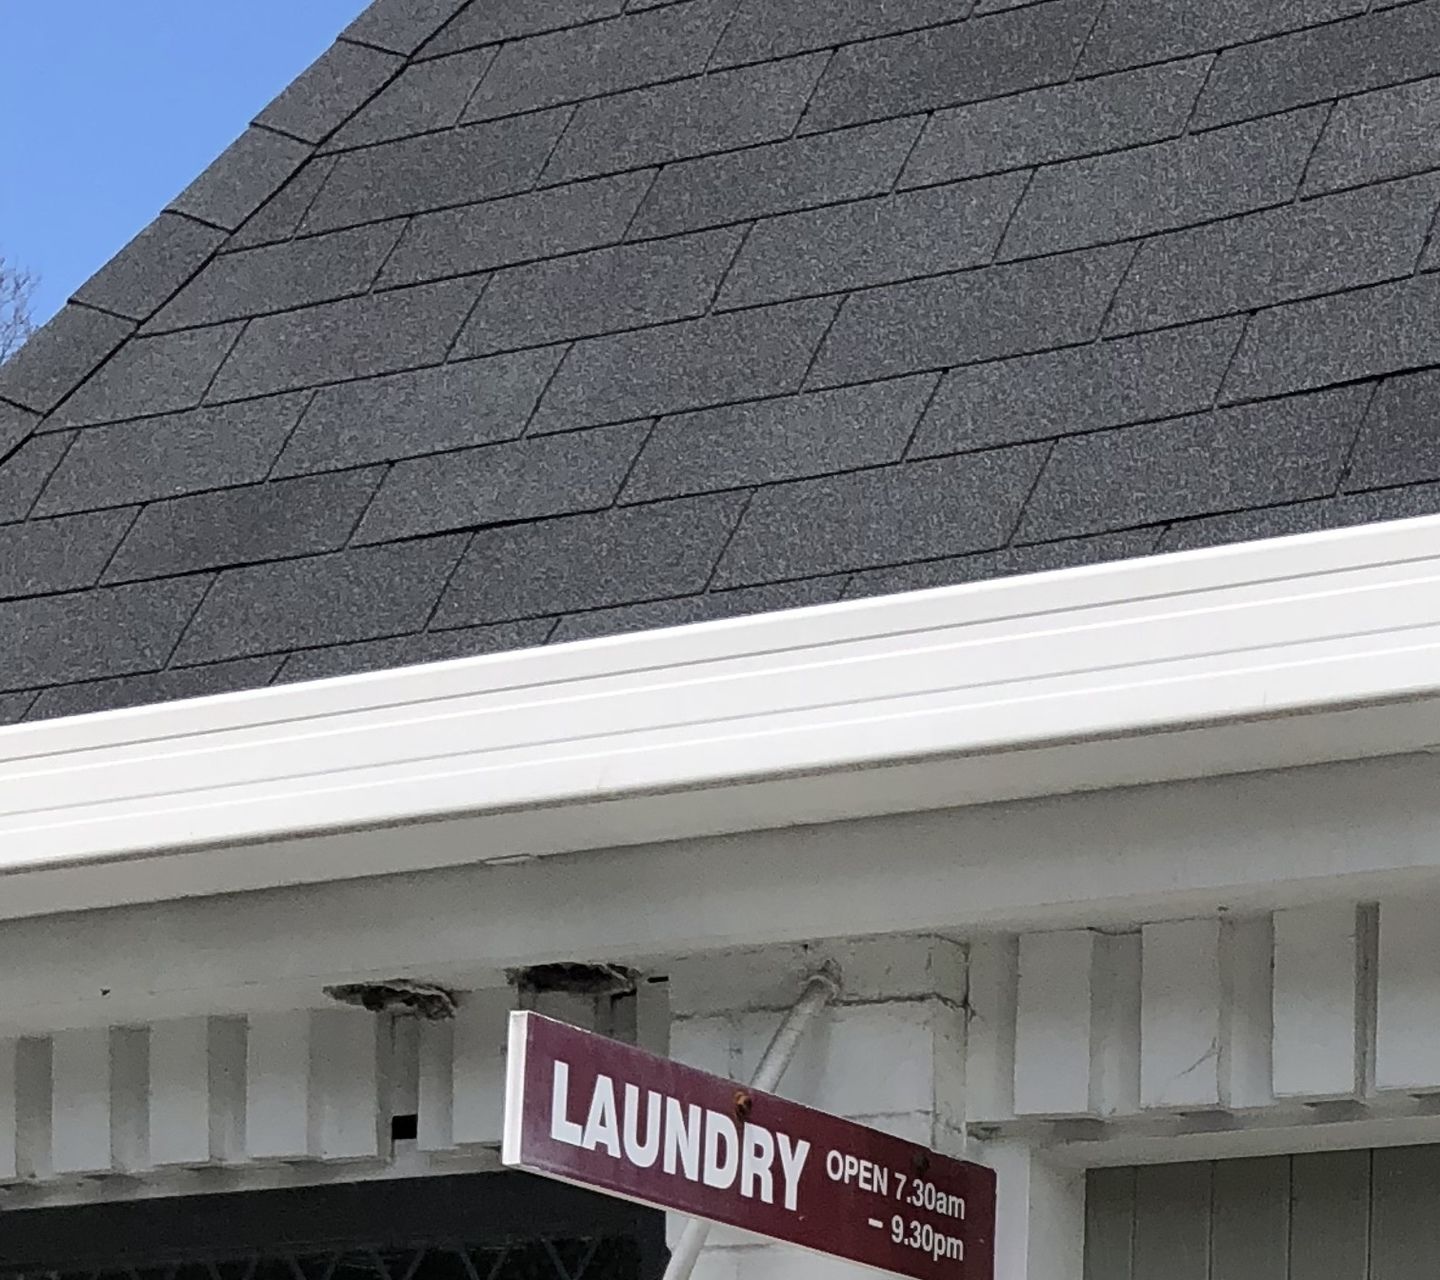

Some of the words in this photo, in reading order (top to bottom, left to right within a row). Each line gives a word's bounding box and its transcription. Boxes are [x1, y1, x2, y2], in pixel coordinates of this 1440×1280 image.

[550, 1060, 811, 1211] LAUNDRY
[826, 1149, 888, 1196] OPEN
[893, 1172, 965, 1221] 7.30am
[891, 1216, 964, 1262] 9.30pm
